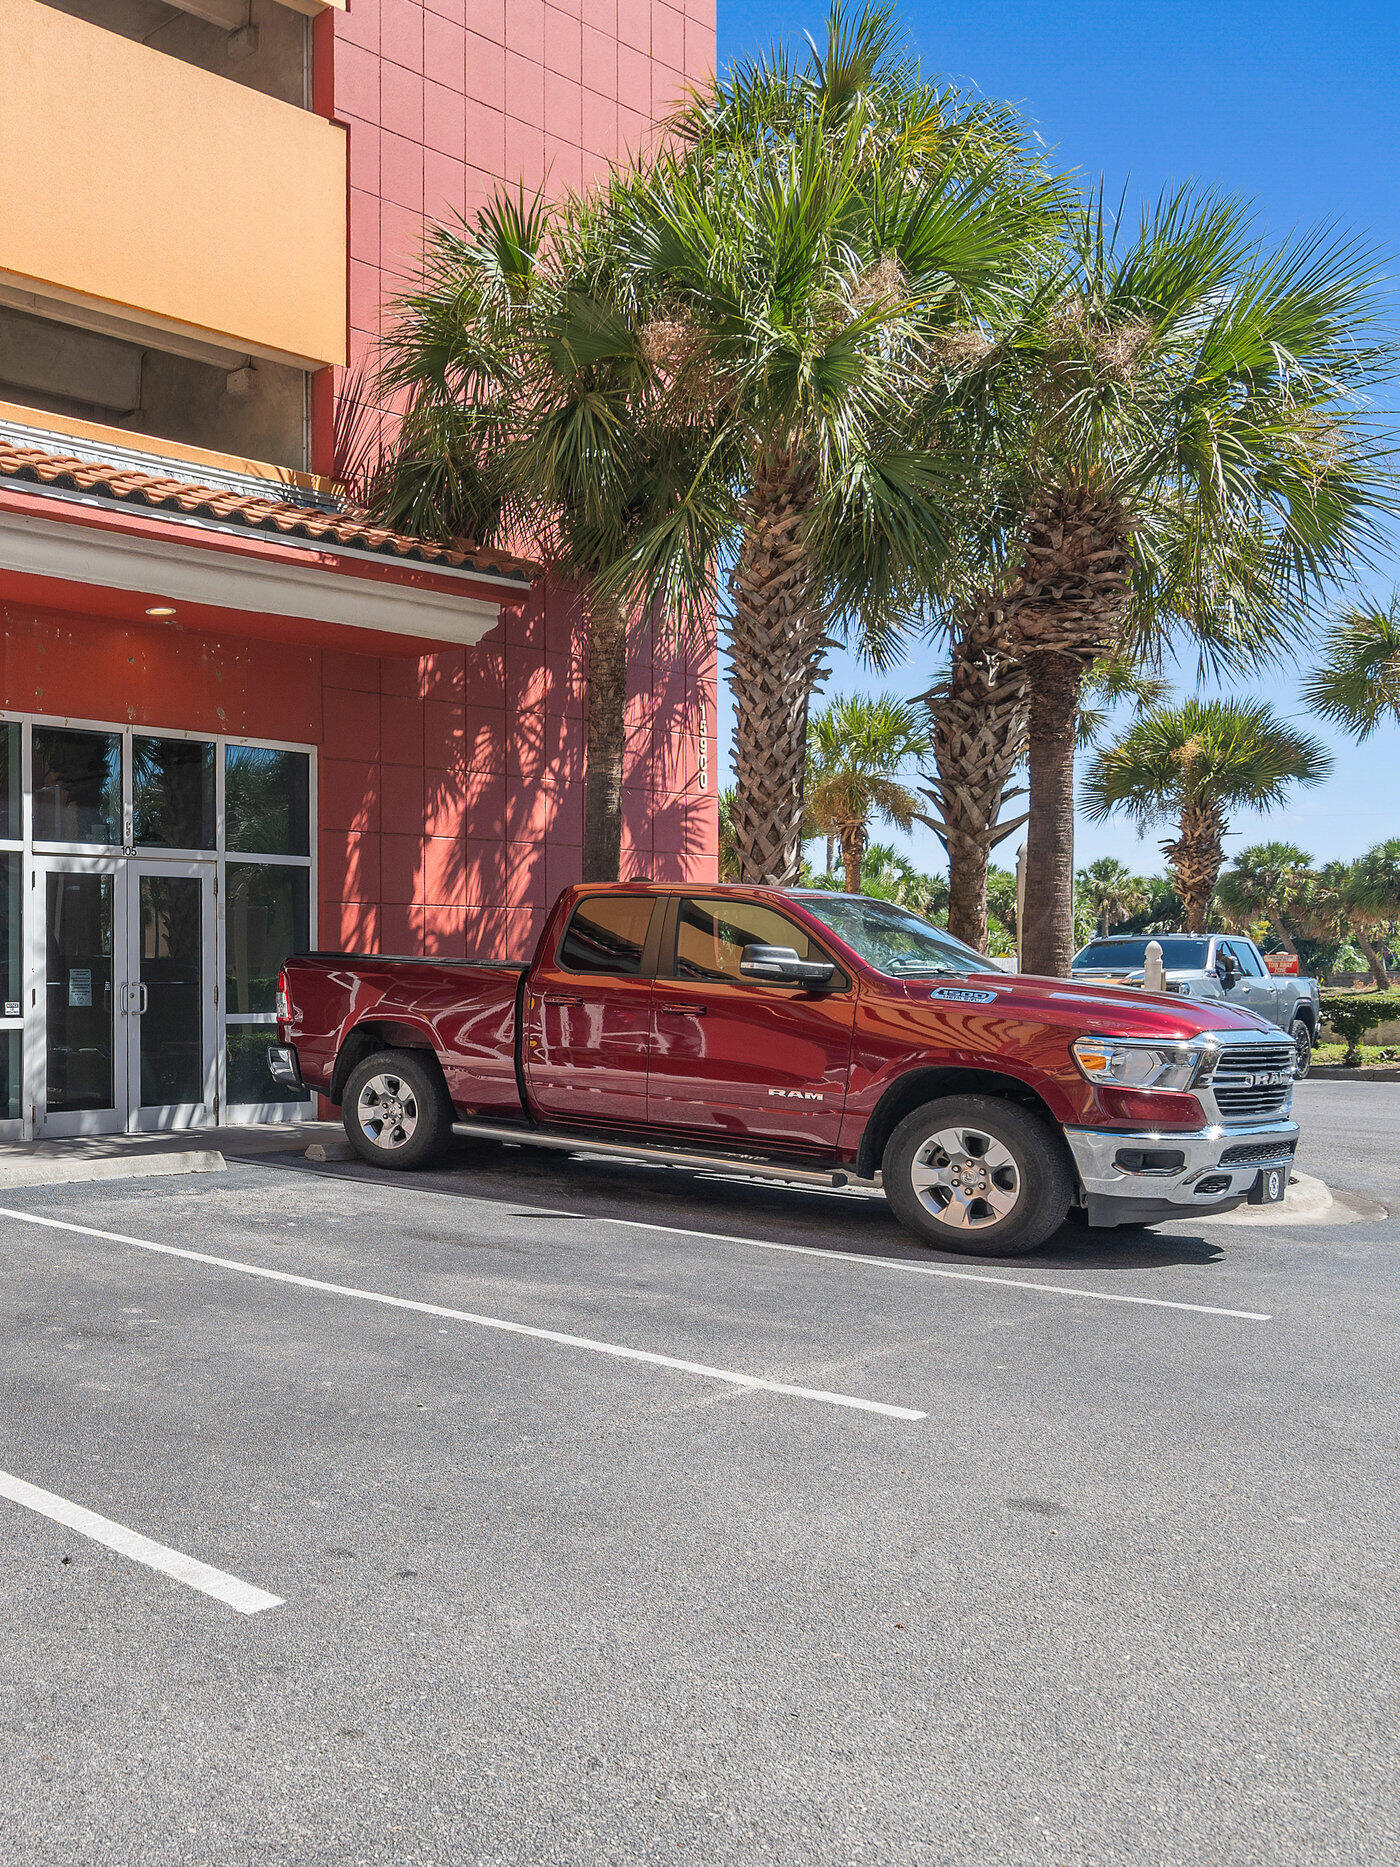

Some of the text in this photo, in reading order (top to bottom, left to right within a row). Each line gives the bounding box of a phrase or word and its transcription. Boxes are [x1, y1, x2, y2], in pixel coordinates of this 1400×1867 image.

[121, 846, 137, 857] 105
[1254, 1070, 1292, 1085] RAM
[768, 1088, 824, 1101] RAM
